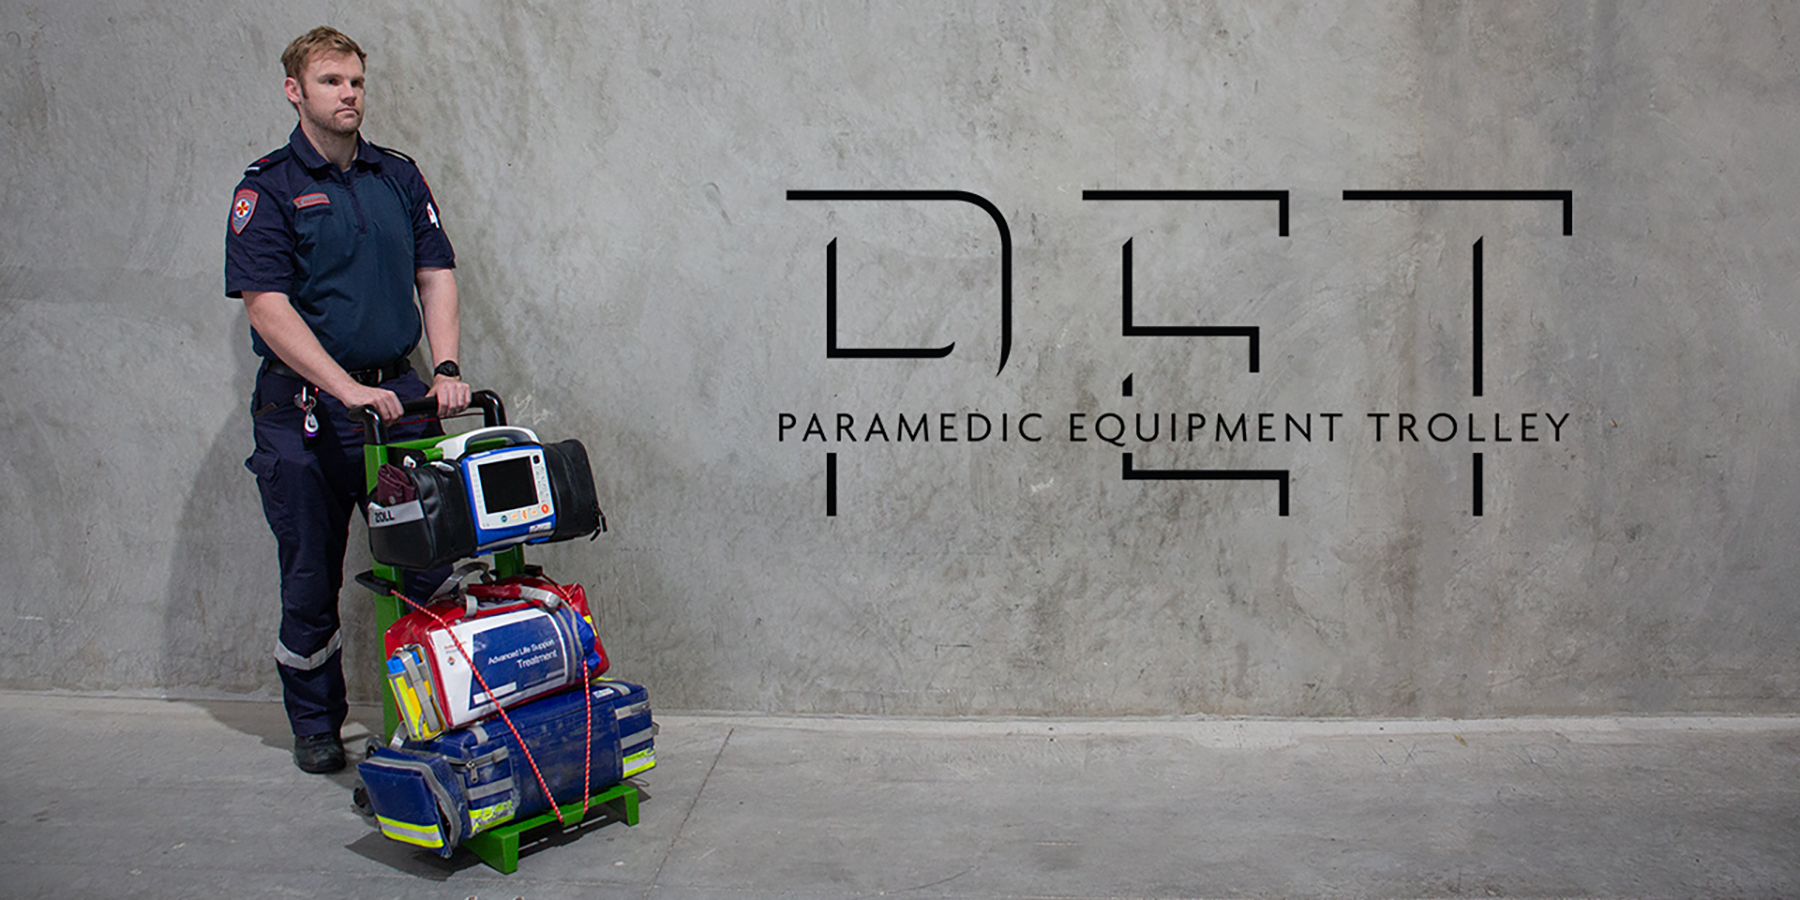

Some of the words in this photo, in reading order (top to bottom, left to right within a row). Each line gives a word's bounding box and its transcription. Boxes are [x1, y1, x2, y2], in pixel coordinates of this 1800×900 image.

[488, 649, 520, 665] Advanced
[519, 647, 531, 656] Life
[530, 639, 555, 652] Support
[516, 649, 557, 669] Treatment
